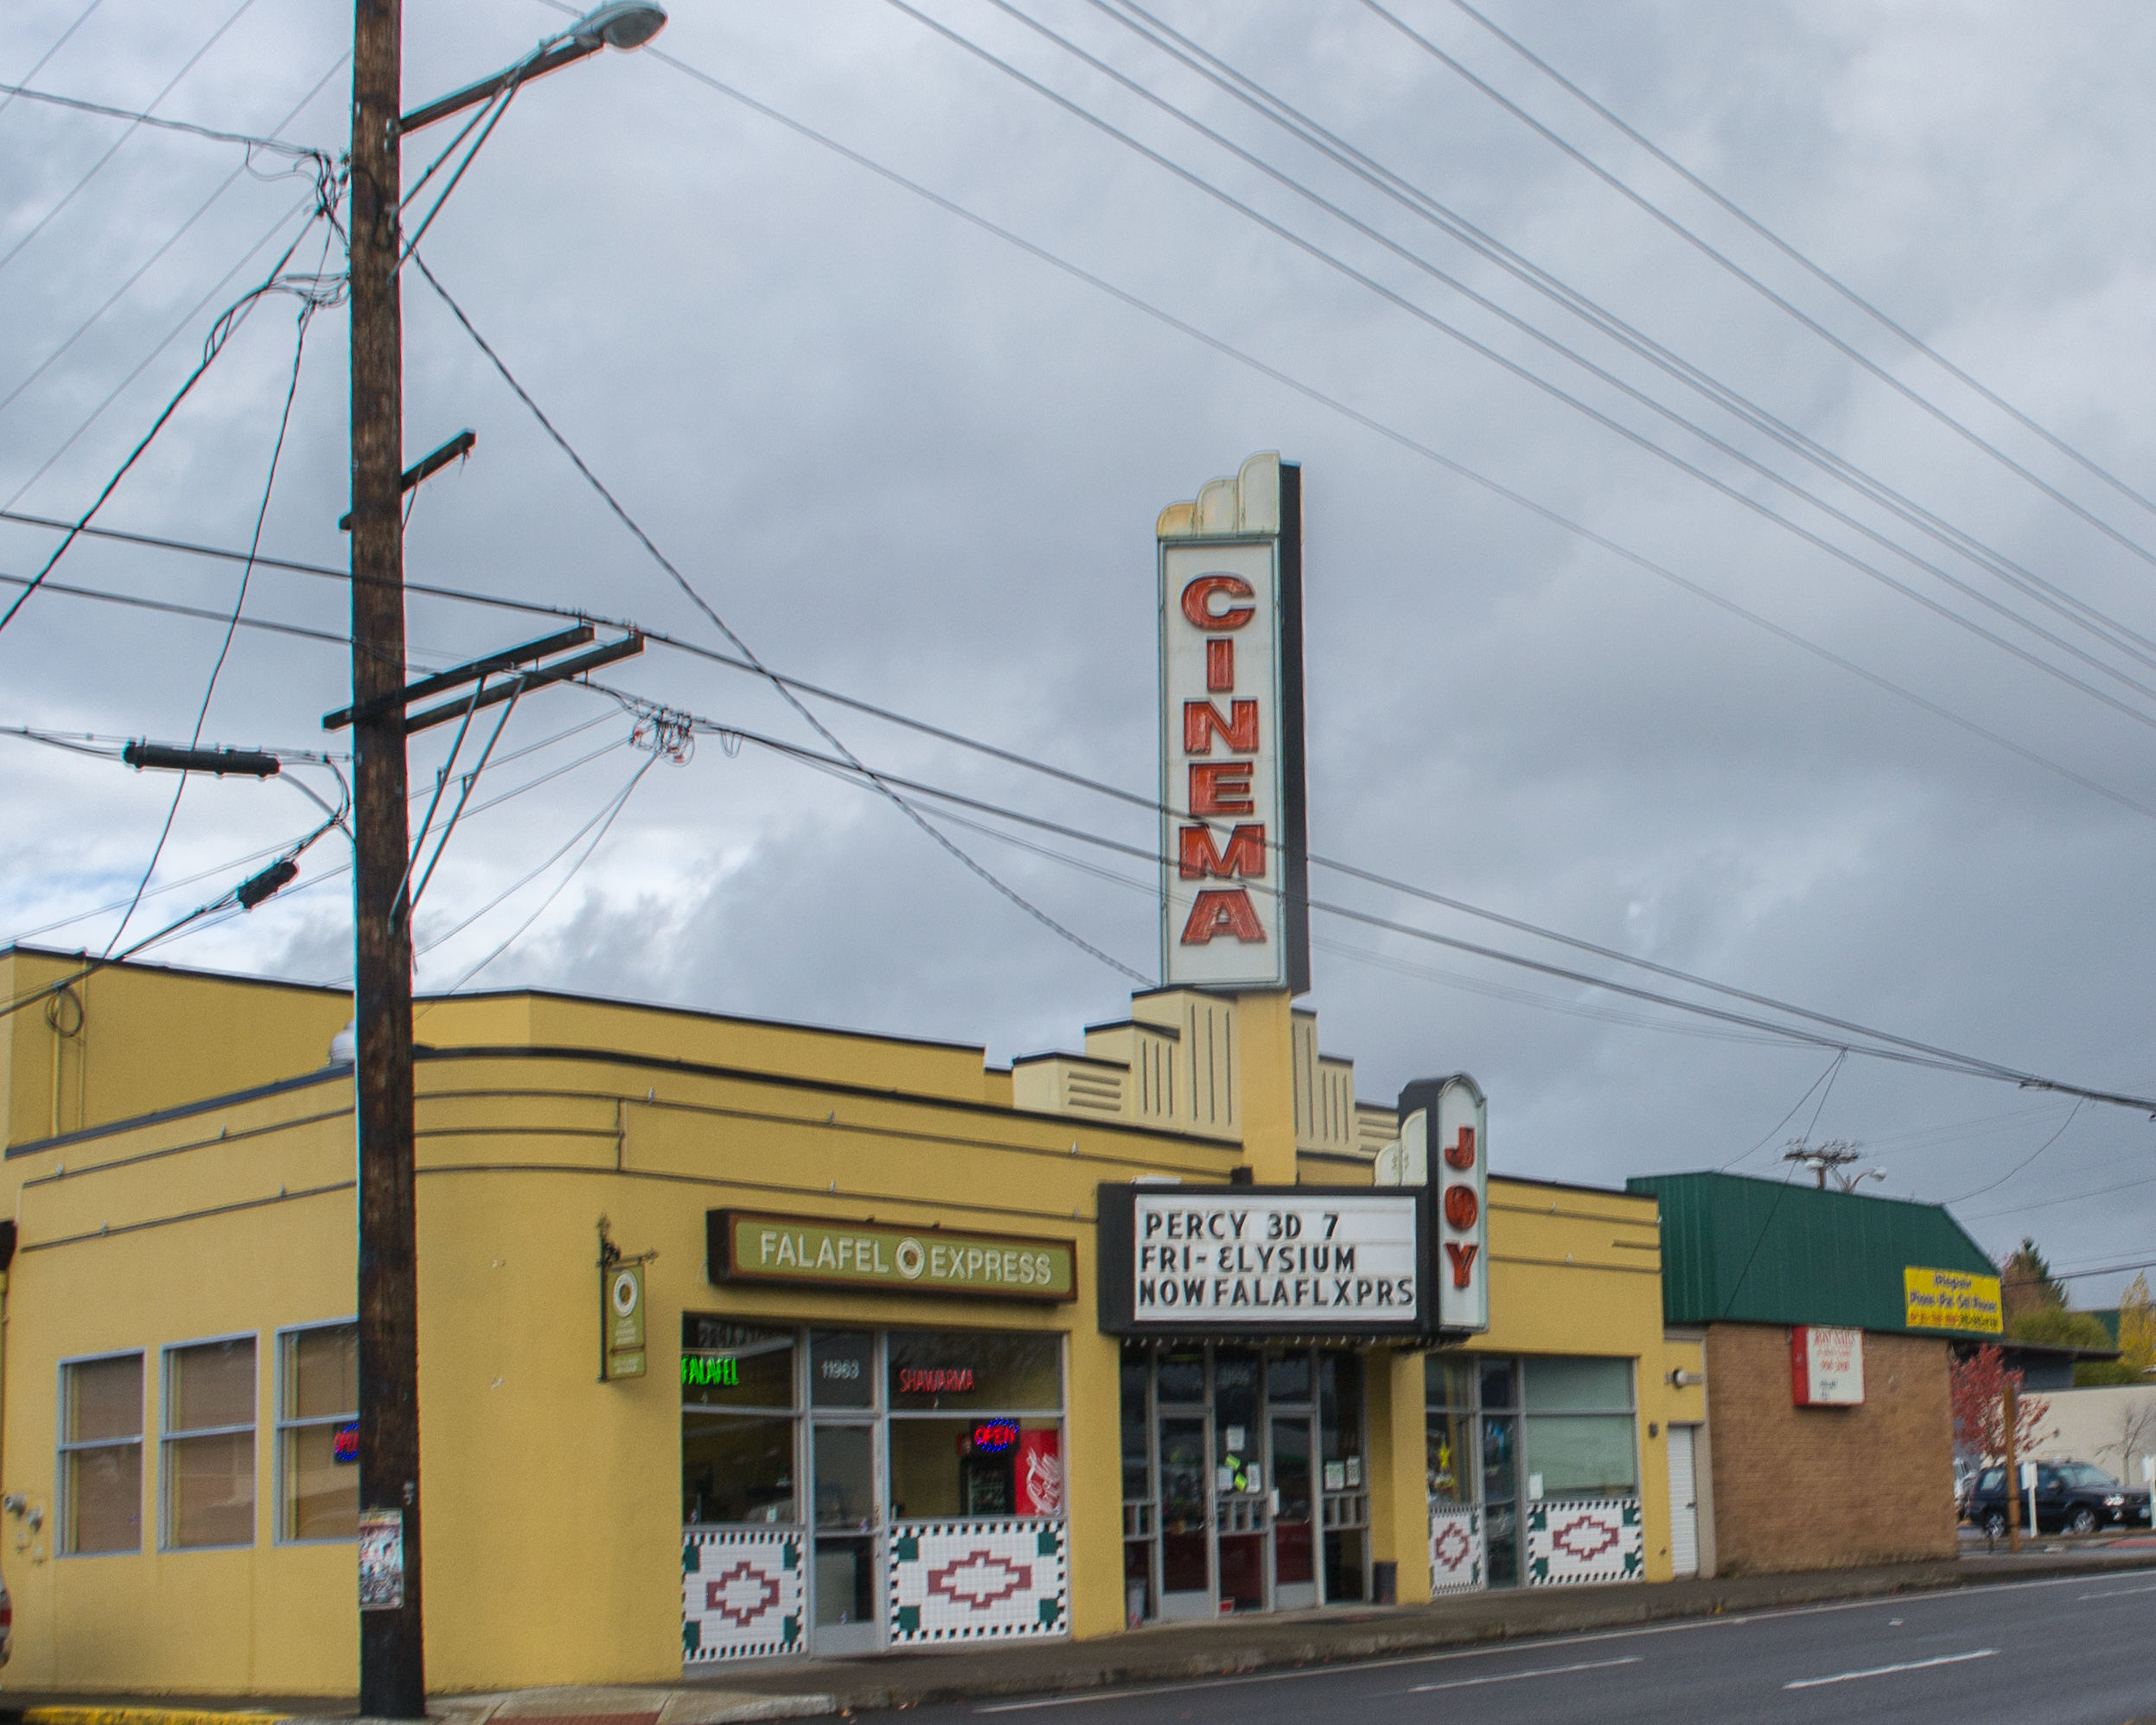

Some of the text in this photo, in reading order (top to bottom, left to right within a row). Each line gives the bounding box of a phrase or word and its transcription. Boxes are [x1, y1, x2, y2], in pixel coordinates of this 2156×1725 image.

[1179, 572, 1266, 945] CINEMA
[1444, 1126, 1479, 1288] JOY
[1145, 1211, 1340, 1240] PERCY 3D 7
[760, 1230, 1052, 1286] FALAFEL EXPRESS
[1139, 1244, 1357, 1273] FRI- ELYSIUM
[1139, 1279, 1206, 1307] NOW
[681, 1355, 741, 1386] FALAFEL
[899, 1368, 975, 1393] SHAWARMA
[973, 1424, 1017, 1446] OPEN
